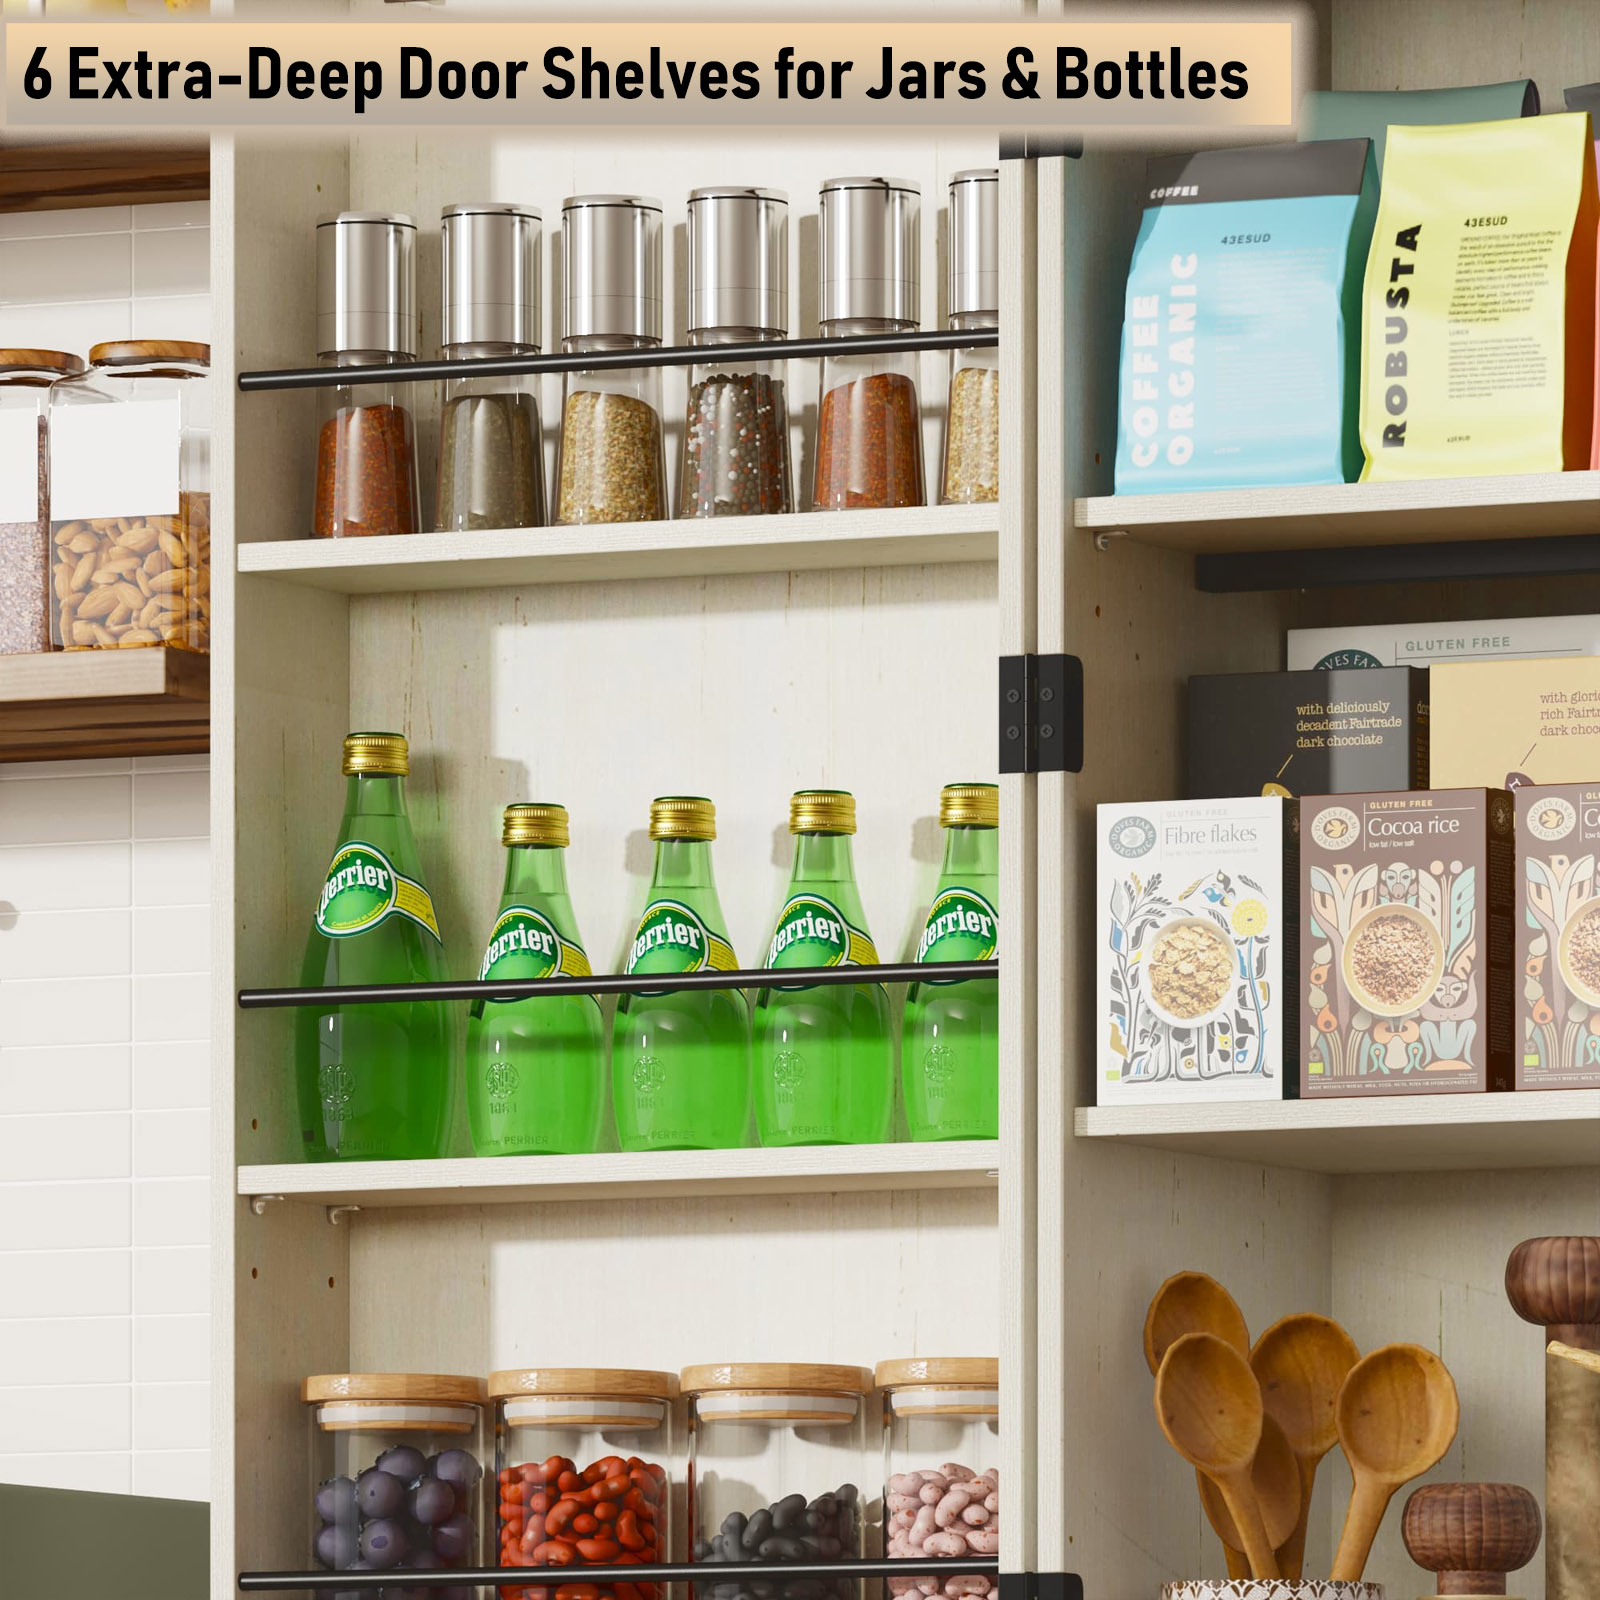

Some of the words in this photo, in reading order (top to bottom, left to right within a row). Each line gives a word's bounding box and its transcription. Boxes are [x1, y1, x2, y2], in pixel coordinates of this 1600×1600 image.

[1150, 185, 1199, 199] COFFEE
[1463, 216, 1508, 227] 43ESUD
[1221, 233, 1271, 245] 43ESUD
[1382, 223, 1423, 448] ROBUSTA
[1167, 253, 1197, 466] ORGANIC
[1131, 294, 1160, 467] COFFEE
[1405, 639, 1465, 651] GLUTEN
[1472, 636, 1511, 648] FREE
[1540, 692, 1567, 704] with
[1296, 703, 1323, 716] with
[1326, 700, 1391, 714] deliciously
[1540, 708, 1564, 720] rich
[1296, 718, 1348, 732] decadent
[1349, 716, 1402, 729] Fairtrade
[1540, 725, 1569, 736] dark
[1571, 724, 1600, 735] choc
[1296, 736, 1325, 748] dark
[1327, 734, 1383, 747] chocolate
[1369, 801, 1406, 809] GLUTEN
[1368, 818, 1423, 836] Cocoa
[1428, 815, 1460, 833] rice
[1165, 825, 1206, 844] Fibre
[1211, 823, 1257, 842] flakes
